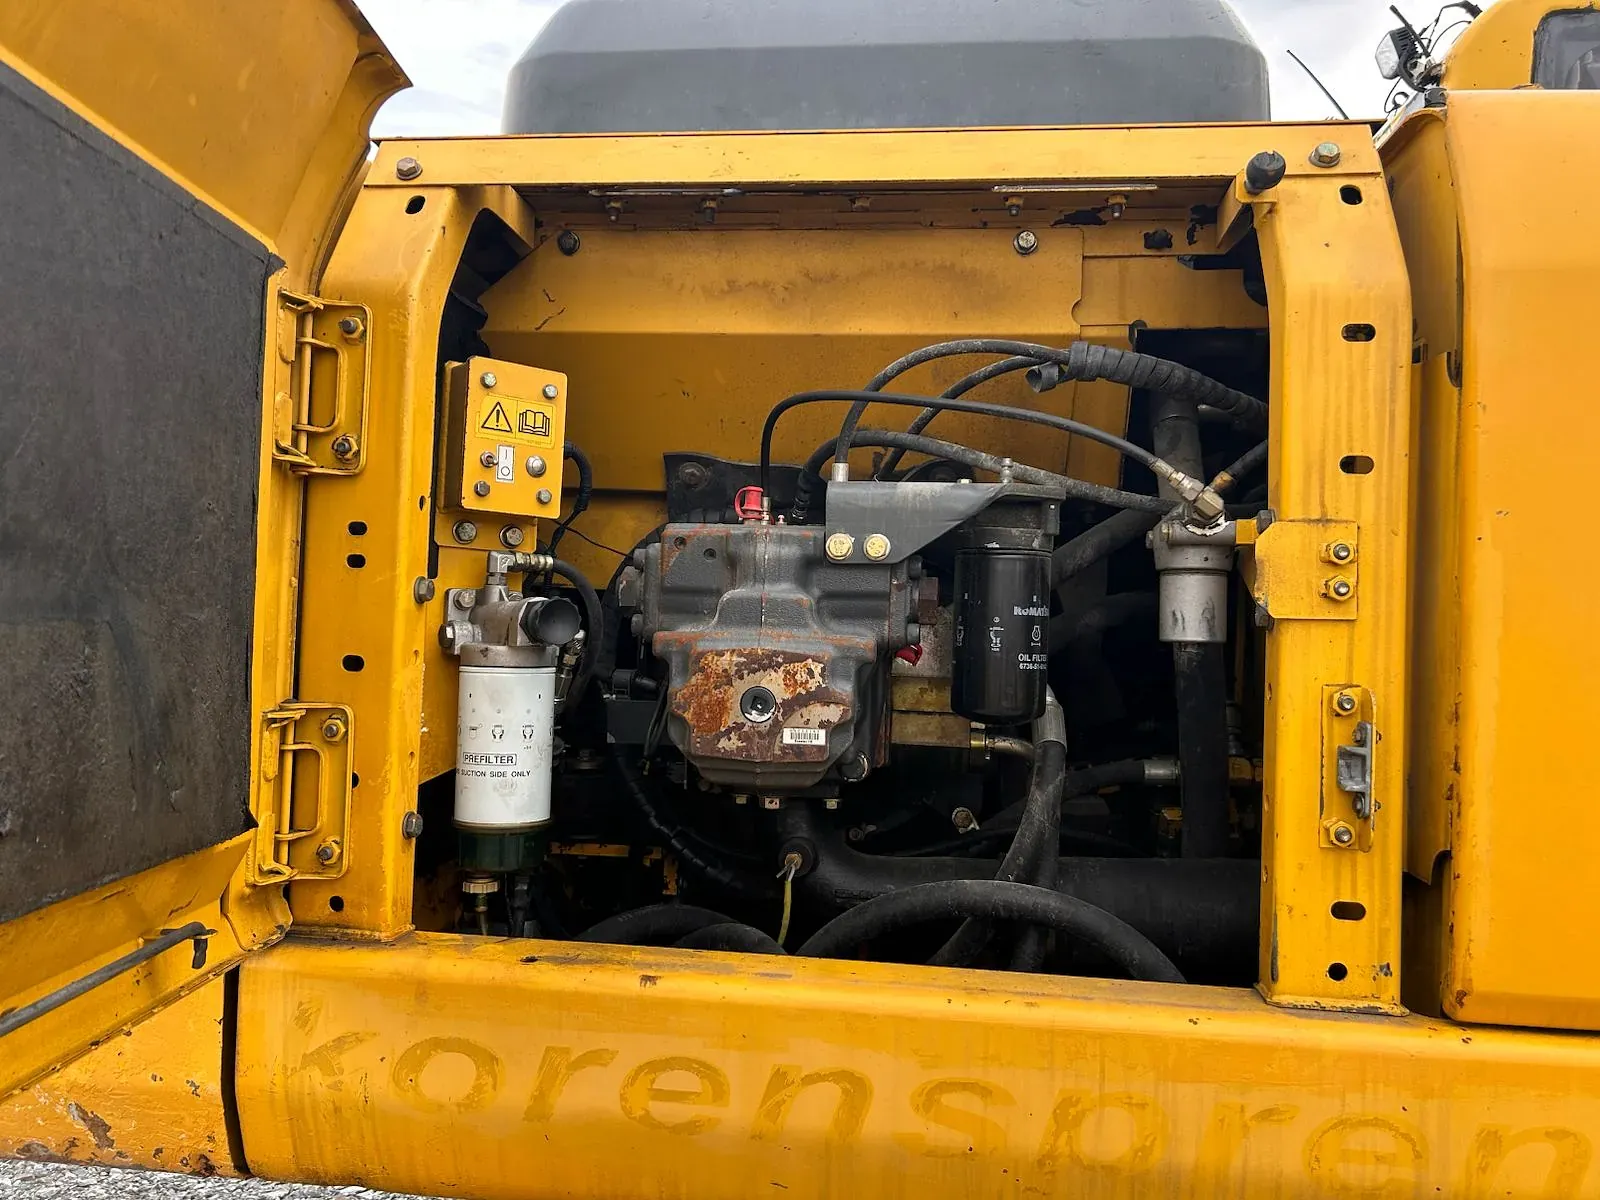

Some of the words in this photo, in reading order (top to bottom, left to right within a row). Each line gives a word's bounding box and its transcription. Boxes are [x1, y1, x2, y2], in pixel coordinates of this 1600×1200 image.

[1018, 653, 1031, 662] OIL
[464, 754, 514, 764] PREFILTER
[461, 769, 486, 777] SUCTION
[489, 770, 508, 778] SIDE
